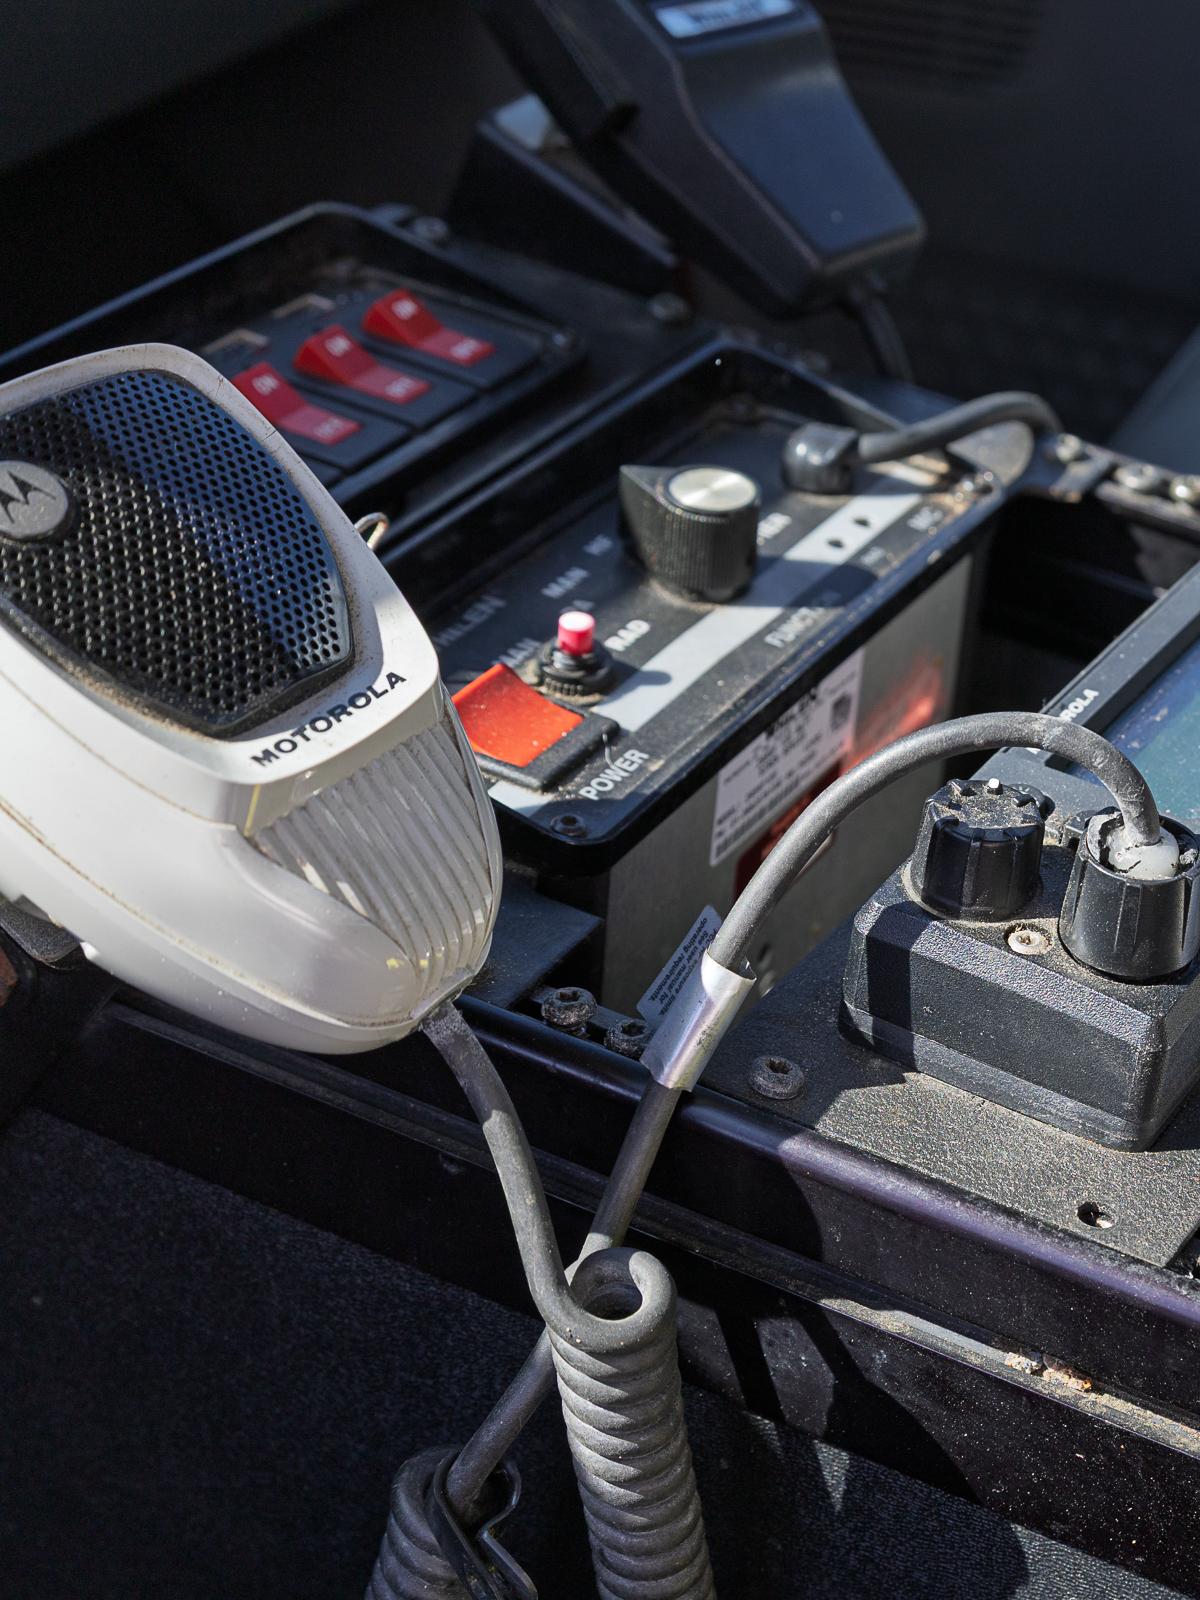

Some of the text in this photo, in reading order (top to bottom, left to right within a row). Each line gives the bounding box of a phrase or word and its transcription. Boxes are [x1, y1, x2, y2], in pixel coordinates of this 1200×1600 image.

[604, 619, 651, 652] RAD
[250, 671, 407, 767] MOTOROLA
[579, 748, 650, 800] POWER
